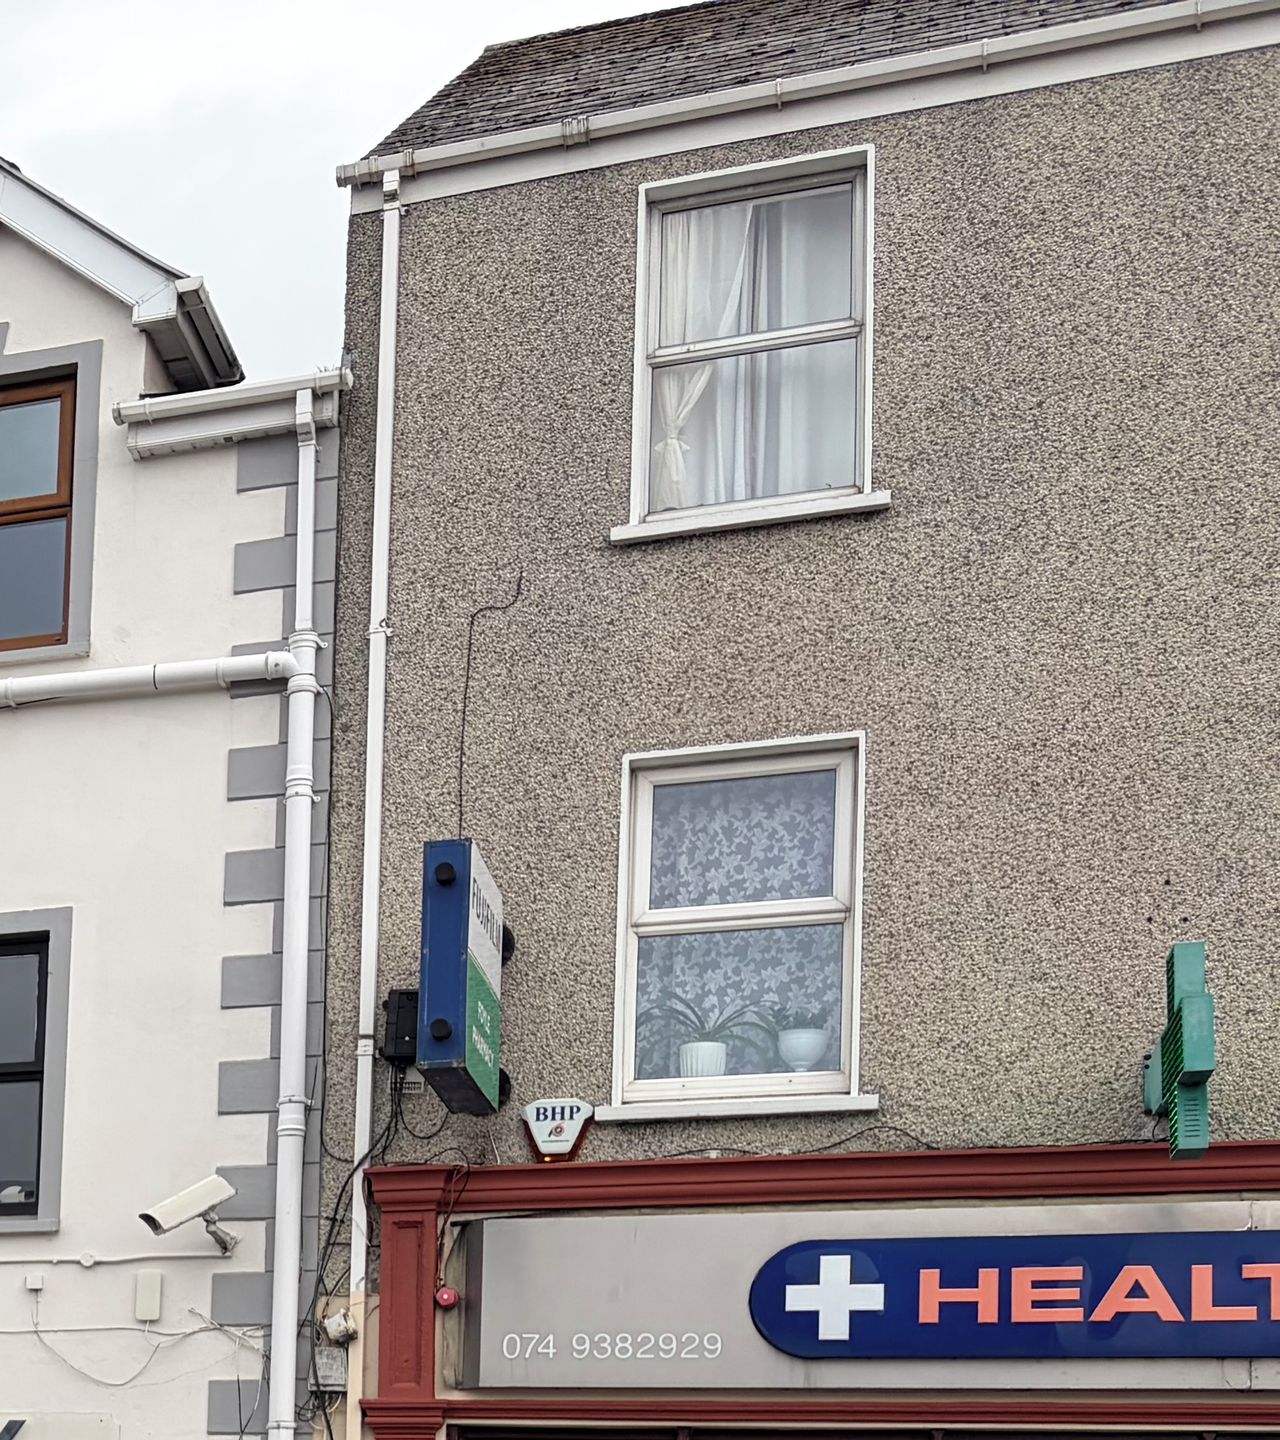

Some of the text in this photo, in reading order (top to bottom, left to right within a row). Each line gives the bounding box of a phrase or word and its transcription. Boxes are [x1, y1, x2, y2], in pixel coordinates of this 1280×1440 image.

[472, 876, 501, 955] FUJIFILM
[535, 1105, 582, 1122] BHP
[501, 1332, 723, 1360] 074 9382929
